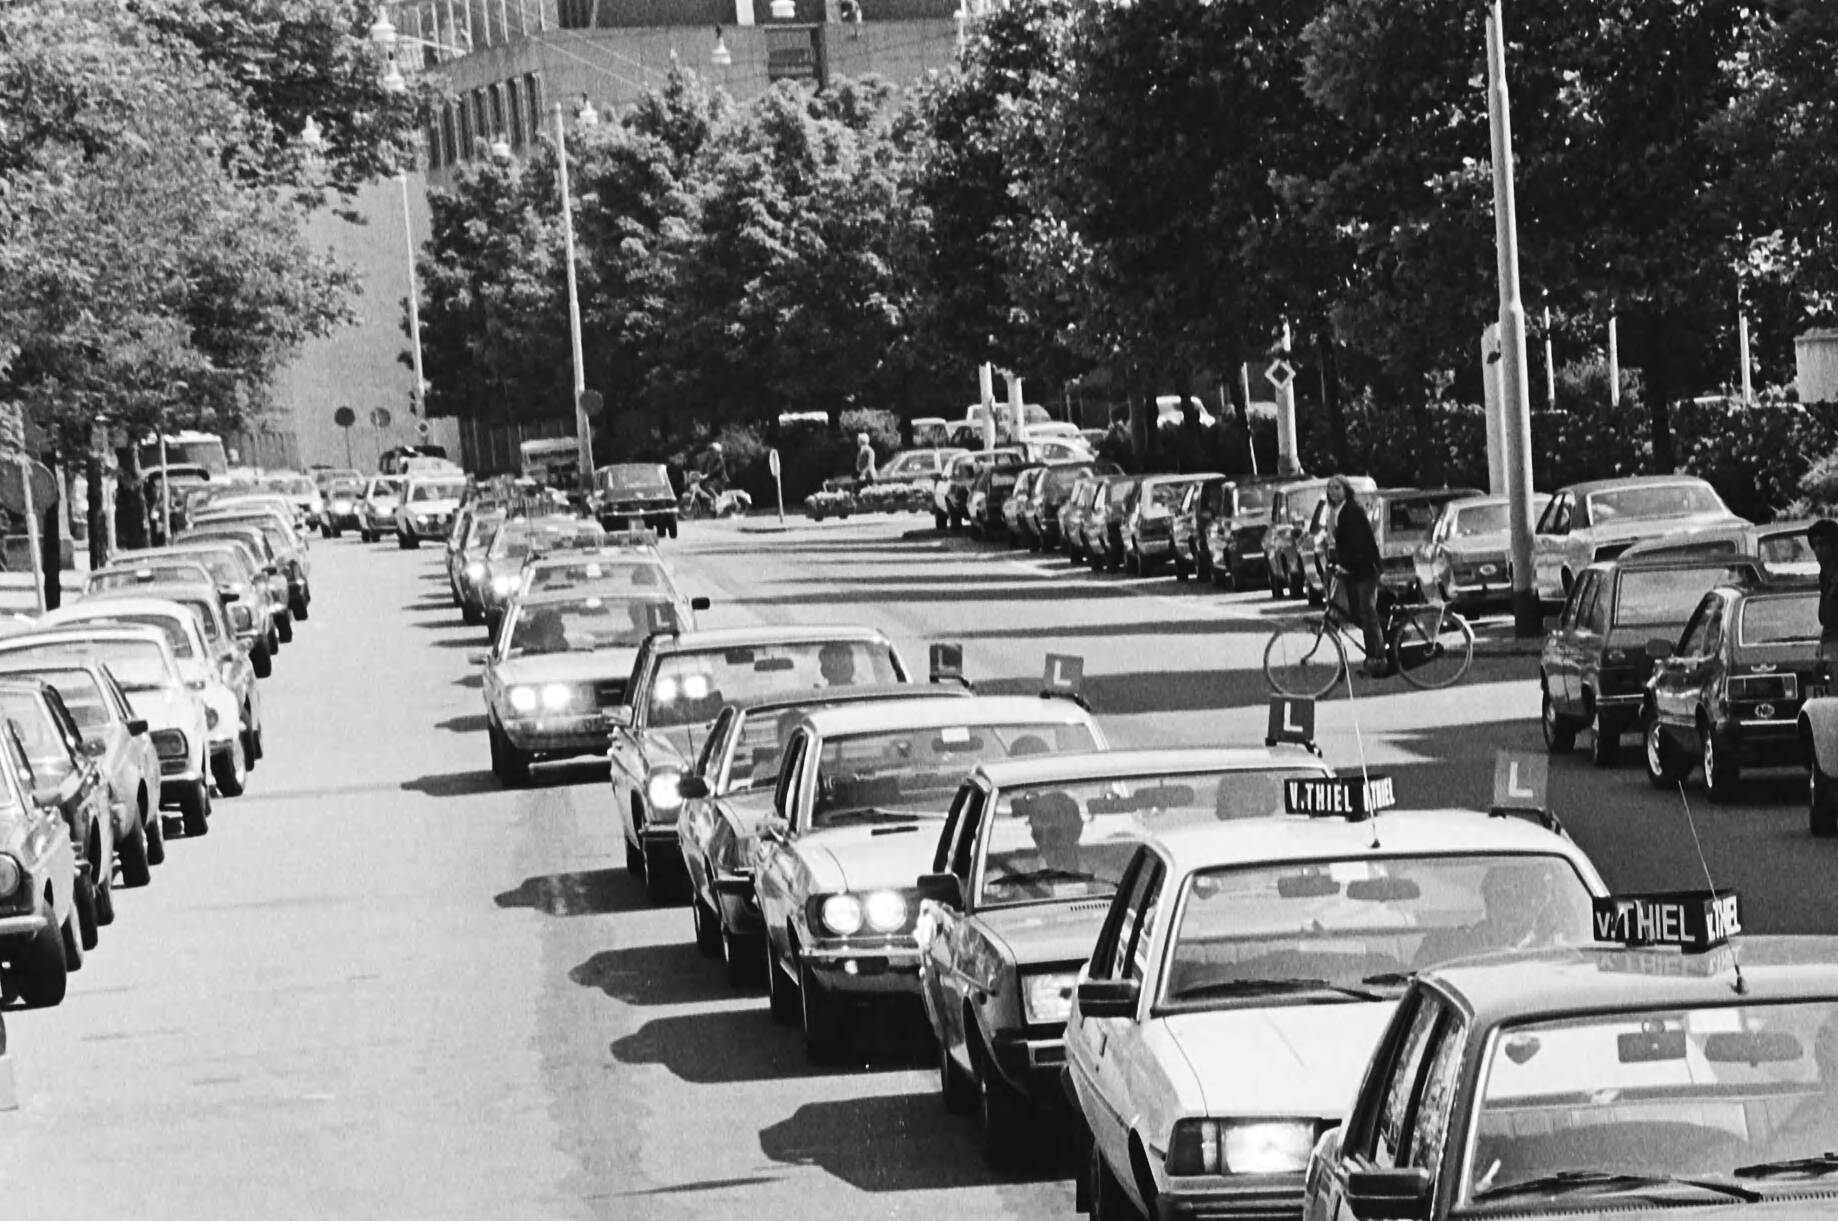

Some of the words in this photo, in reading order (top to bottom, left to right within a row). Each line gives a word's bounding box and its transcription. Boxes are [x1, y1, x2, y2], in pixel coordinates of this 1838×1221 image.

[655, 607, 670, 627] L
[937, 649, 956, 671] L
[1053, 660, 1072, 687] L
[1283, 701, 1303, 732] L
[1508, 761, 1533, 798] L
